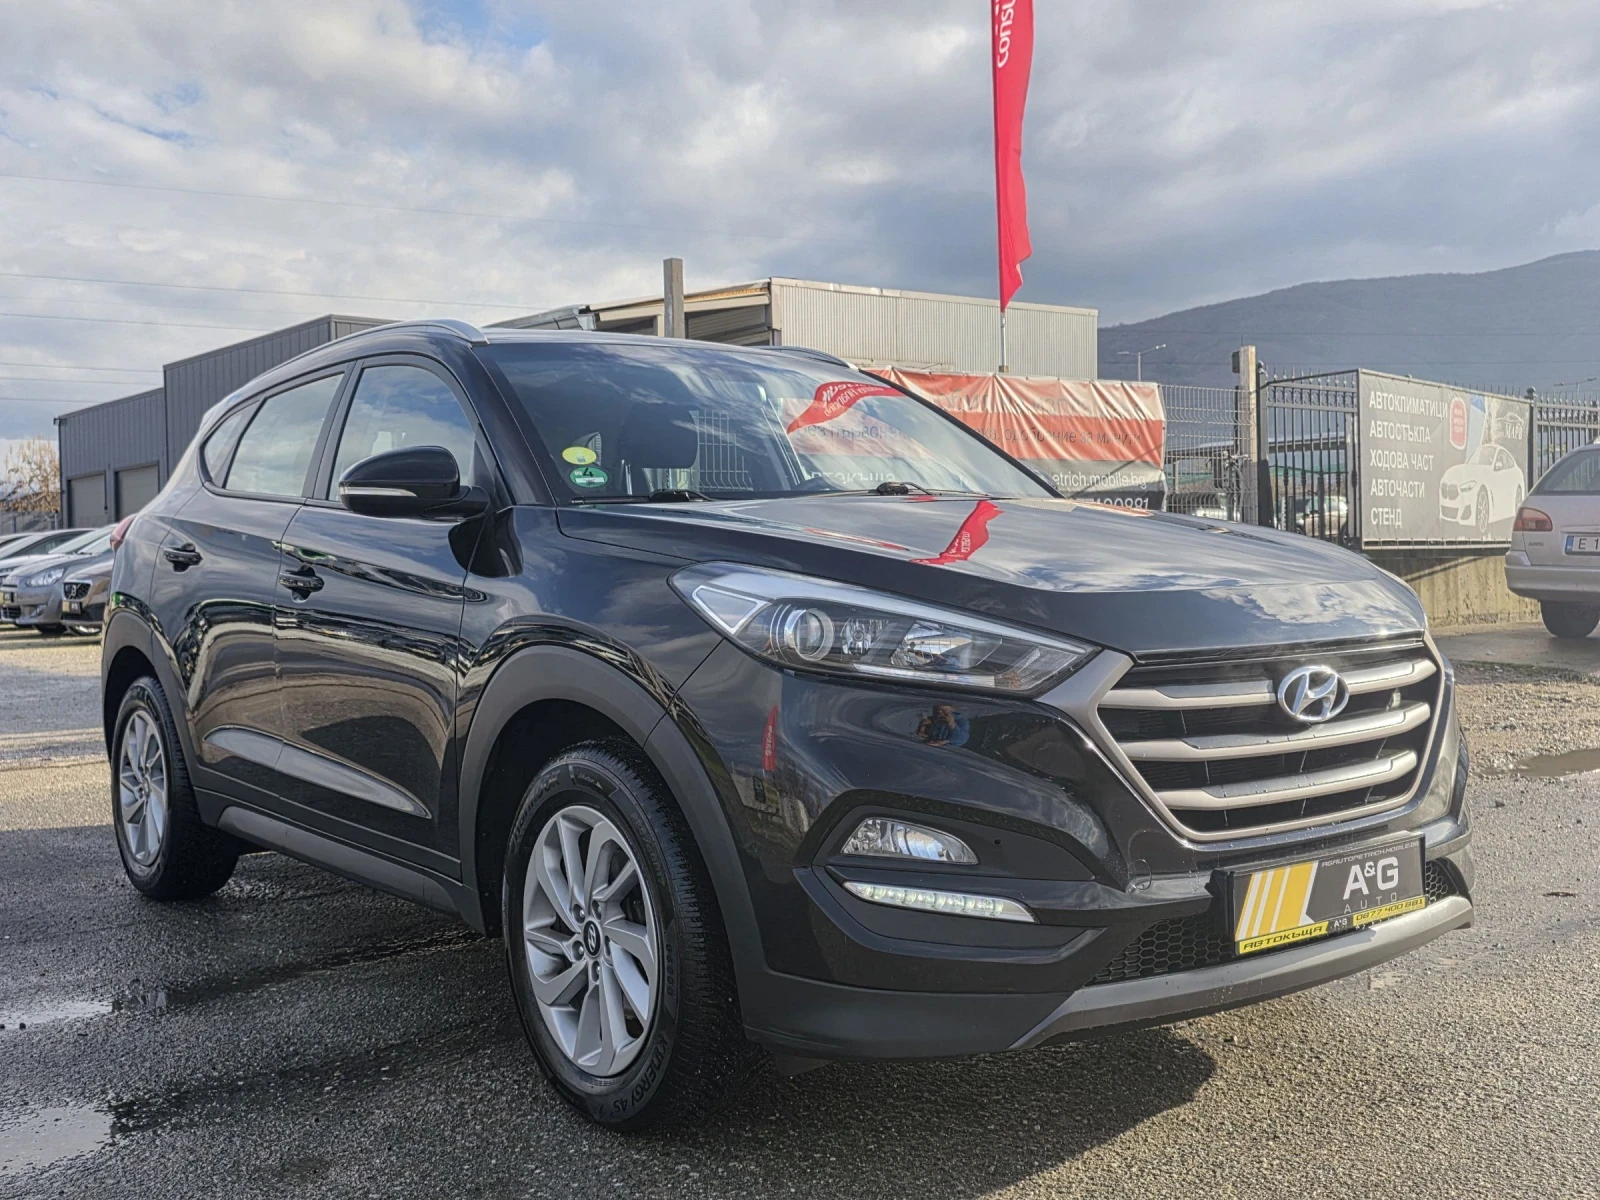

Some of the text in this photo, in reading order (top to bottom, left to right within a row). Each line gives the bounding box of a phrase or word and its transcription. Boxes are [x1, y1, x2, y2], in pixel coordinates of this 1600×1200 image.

[1369, 390, 1448, 420] АВТОКЛИМАТИЦИ
[1369, 420, 1431, 443] АВТОСТЪКЛА
[1370, 448, 1434, 471] ХОДОВА ЧАСТ
[1370, 478, 1425, 498] АВТОЧАСТИ
[1370, 507, 1402, 528] СТЕНД
[1343, 856, 1399, 900] A&G
[1356, 909, 1382, 920] 0877
[1404, 898, 1423, 908] 881
[1243, 925, 1323, 950] АВТОКЪЩА
